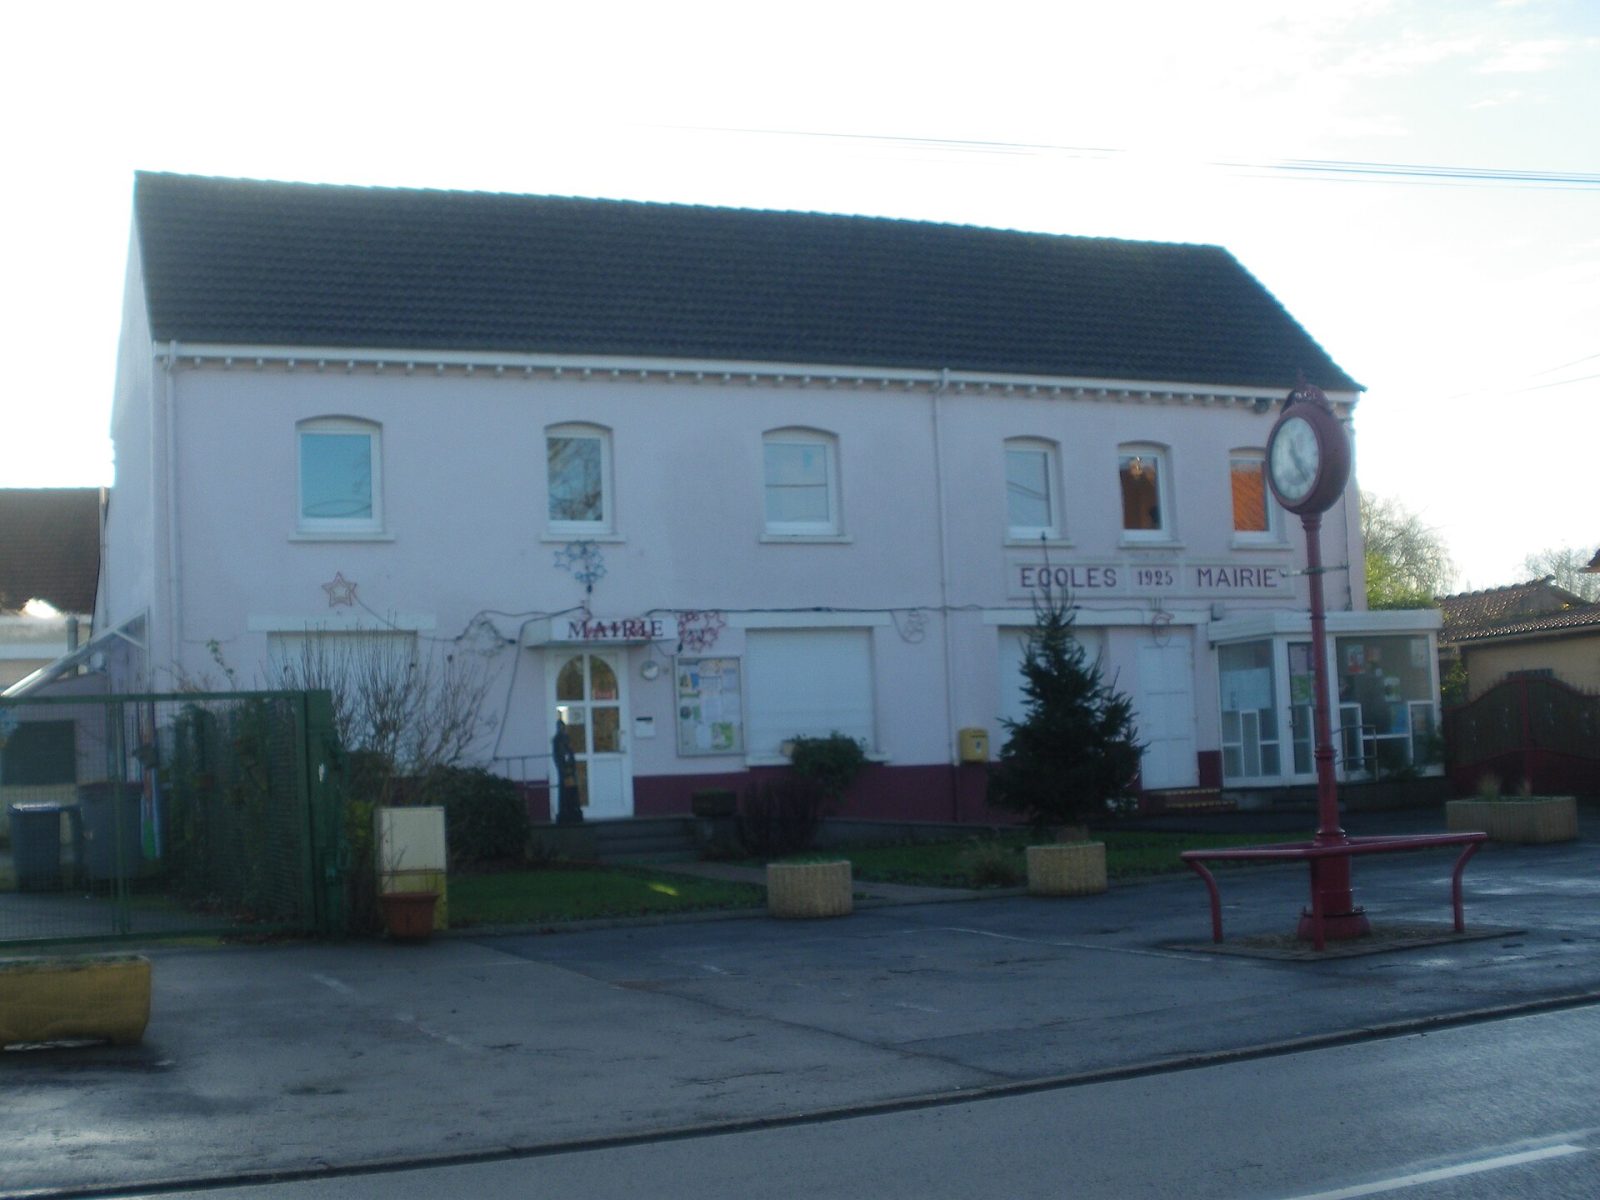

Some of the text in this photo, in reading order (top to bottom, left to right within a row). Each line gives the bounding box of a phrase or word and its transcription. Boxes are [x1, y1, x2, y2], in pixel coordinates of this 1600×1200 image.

[1020, 567, 1277, 588] ECOLES 1925 MAIRIE
[568, 620, 664, 638] MAIRIE
